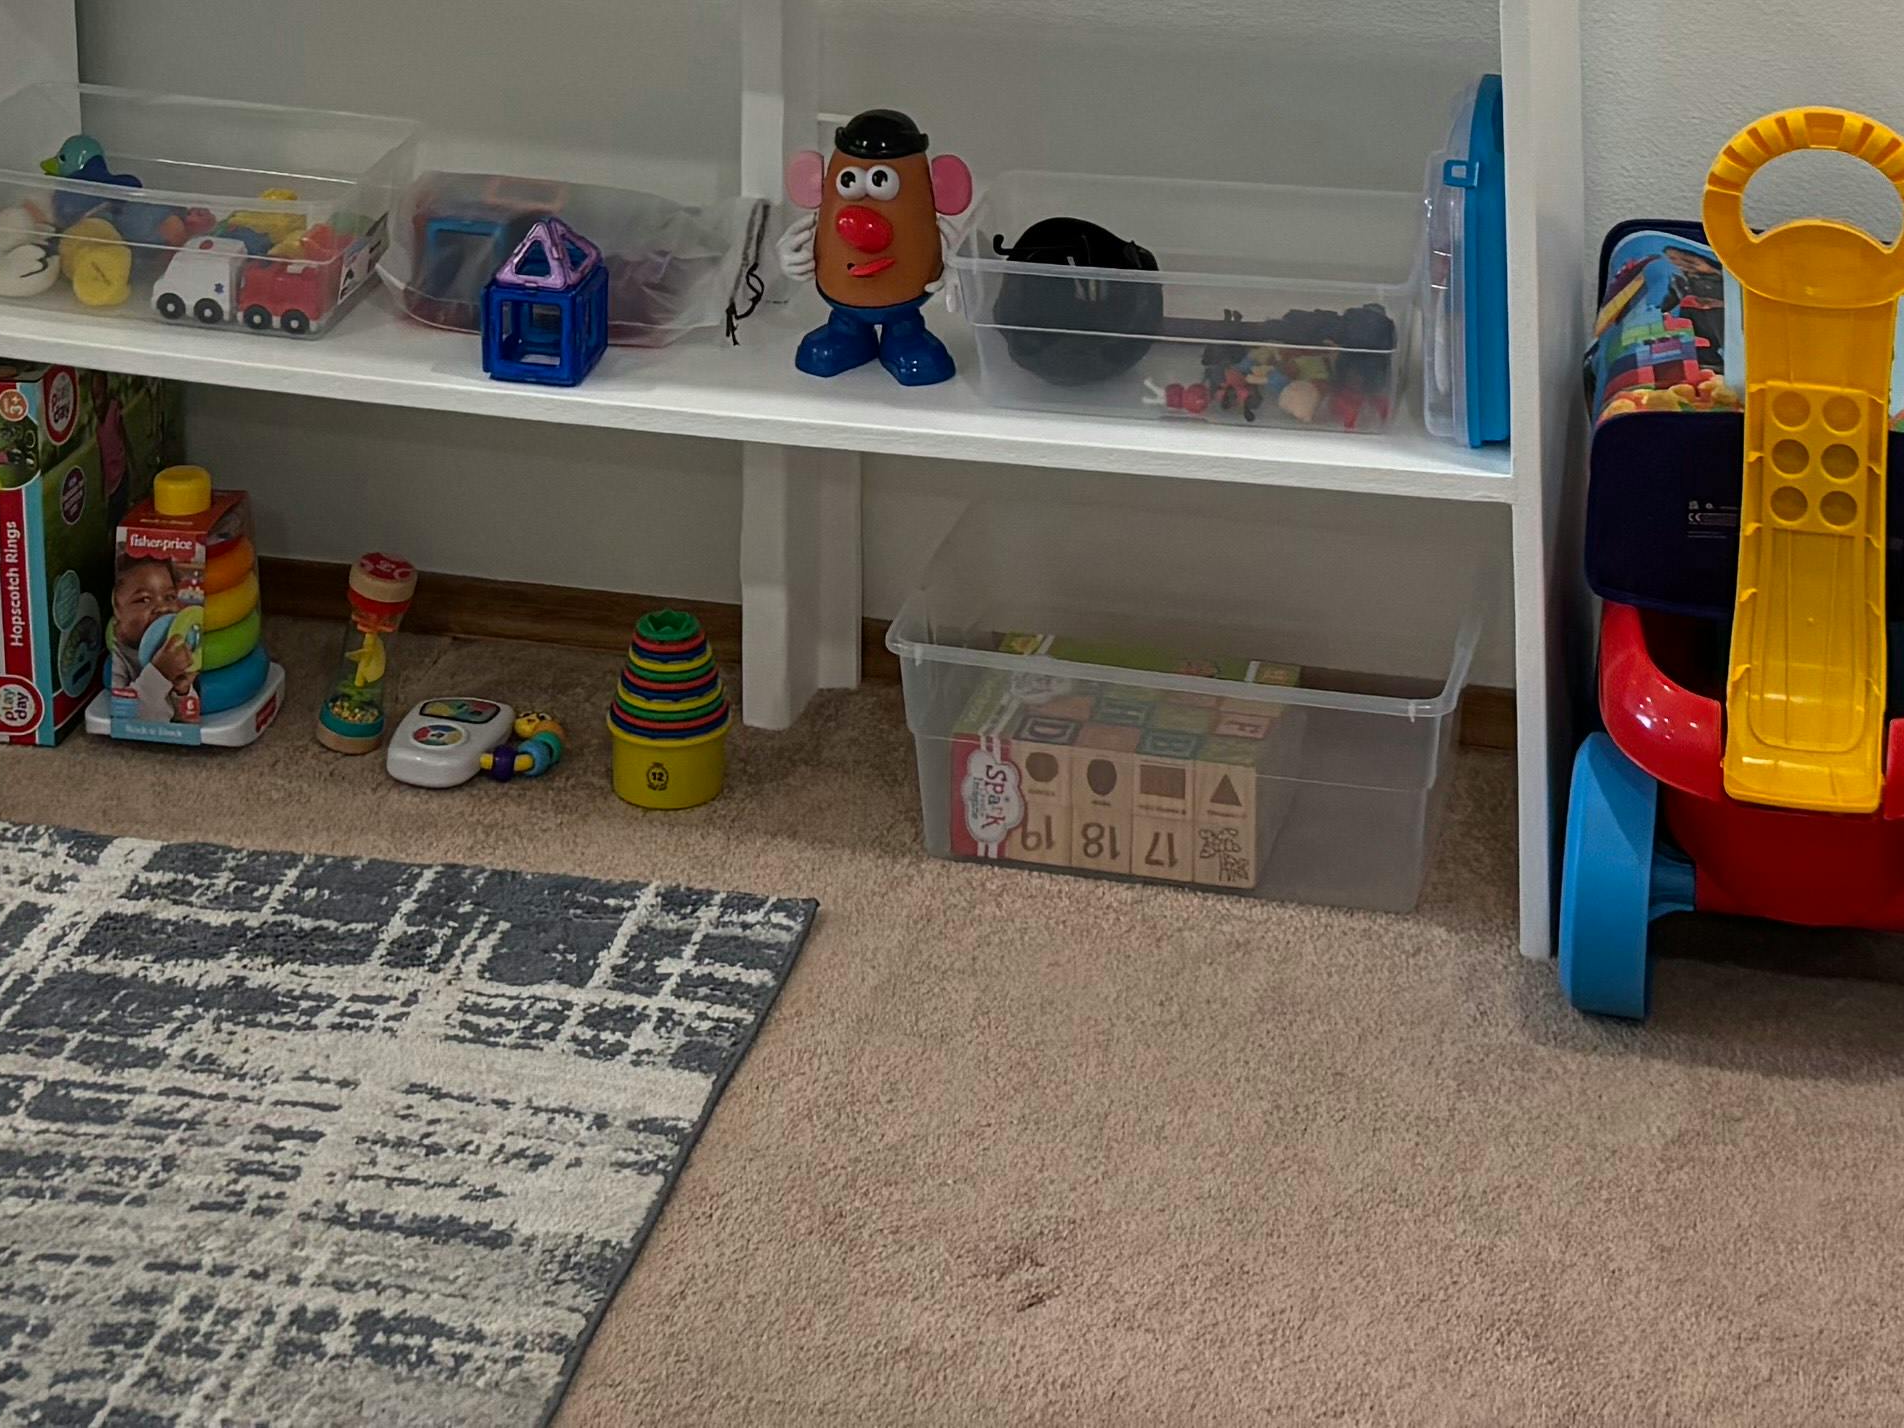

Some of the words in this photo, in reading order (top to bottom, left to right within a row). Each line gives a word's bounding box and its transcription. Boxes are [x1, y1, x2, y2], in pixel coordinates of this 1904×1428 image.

[5, 521, 22, 563] Rings
[129, 533, 193, 551] fisher-price
[5, 568, 24, 646] Hopscotch
[15, 692, 29, 720] day
[981, 764, 1007, 829] Spark
